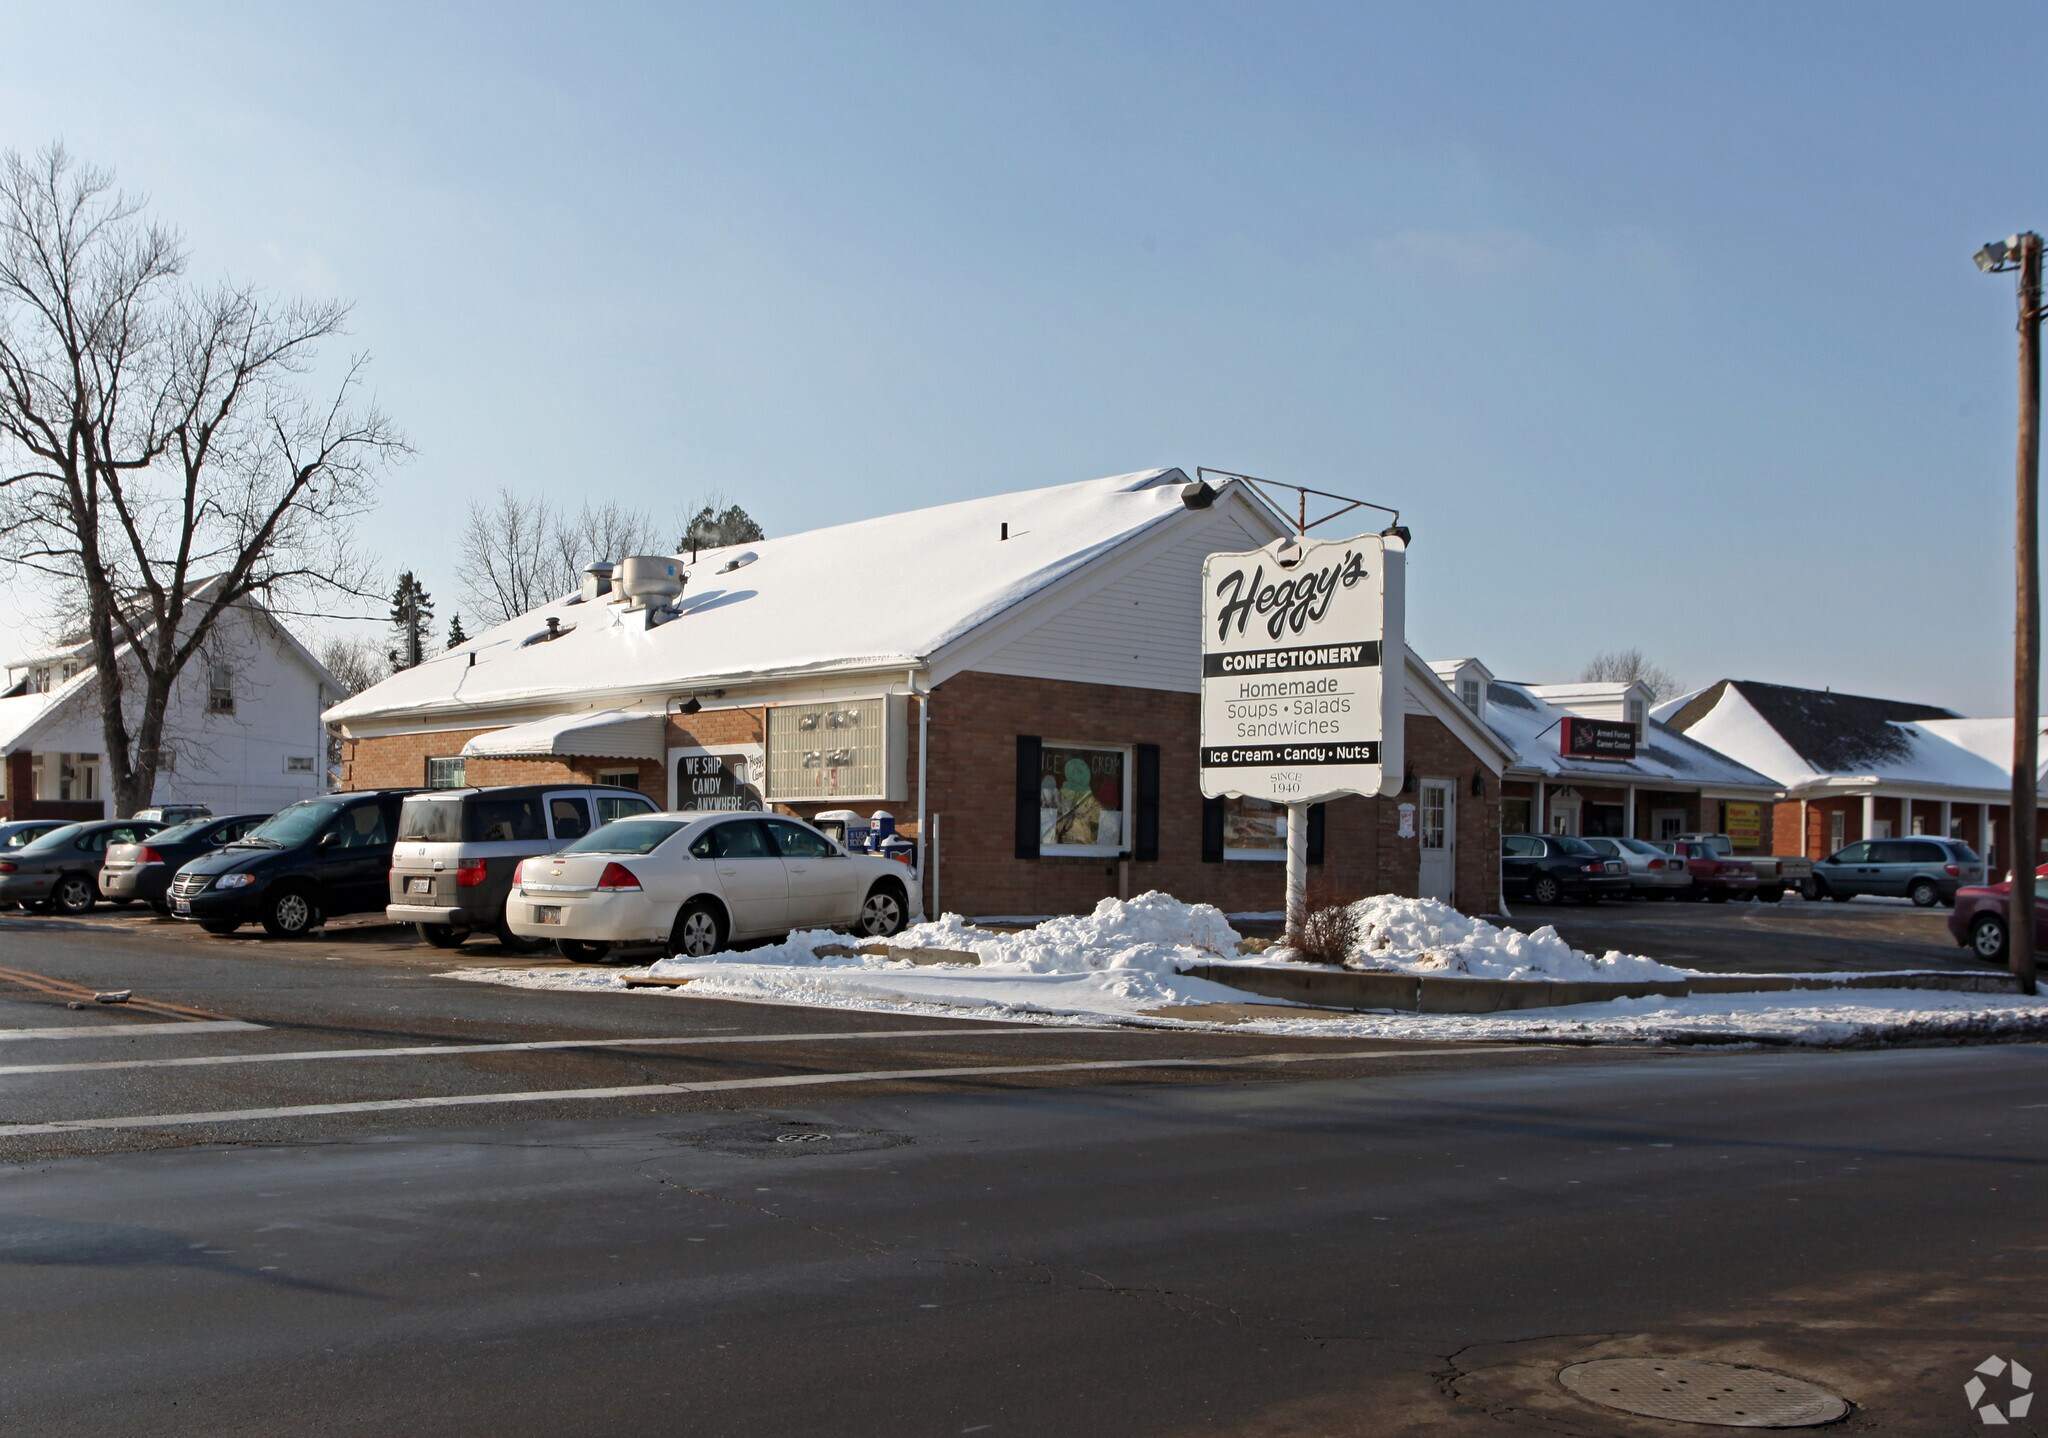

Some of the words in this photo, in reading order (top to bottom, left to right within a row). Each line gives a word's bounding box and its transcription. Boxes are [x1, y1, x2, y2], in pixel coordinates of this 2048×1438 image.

[1216, 549, 1369, 642] Heggy's
[1222, 646, 1363, 671] CONFECTIONERY
[1239, 677, 1338, 698] Homemade
[1227, 702, 1278, 720] Soups
[1293, 698, 1351, 715] Salads
[1237, 719, 1340, 737] Sandwiches
[1596, 729, 1613, 738] Armed
[1614, 730, 1631, 739] Forces
[1596, 740, 1614, 748] Career
[1614, 741, 1631, 749] Center
[1210, 750, 1229, 763] Ice
[1231, 749, 1274, 762] Cream
[1284, 747, 1326, 762] Candy
[1336, 745, 1370, 759] Nuts
[686, 758, 699, 775] WE
[702, 757, 722, 774] SHIP
[1041, 752, 1062, 773] ICE
[1091, 755, 1121, 775] CREAM
[692, 777, 722, 795] CANDY
[1270, 771, 1303, 783] SINCE
[1272, 783, 1300, 793] 1940
[697, 796, 742, 811] ANYWHERE
